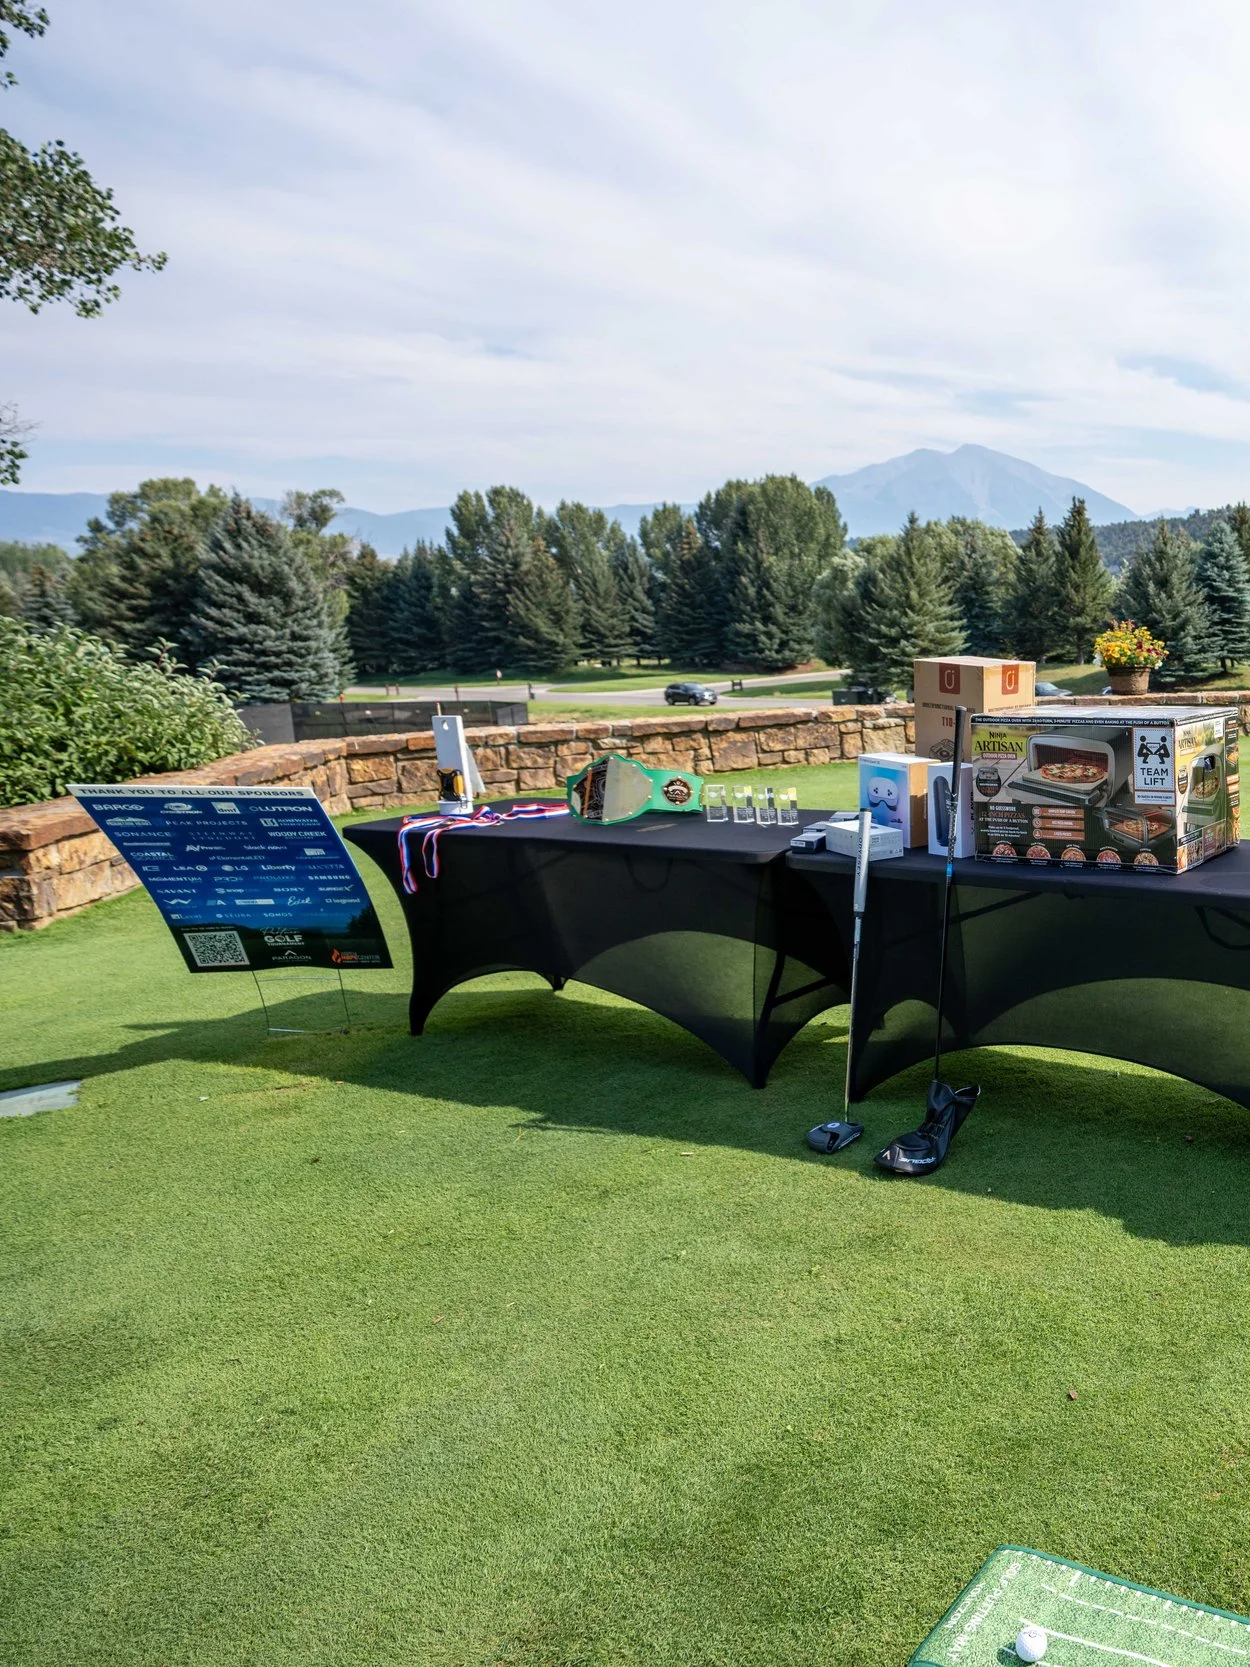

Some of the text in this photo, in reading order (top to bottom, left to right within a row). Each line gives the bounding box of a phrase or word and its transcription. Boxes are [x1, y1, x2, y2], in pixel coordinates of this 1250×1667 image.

[974, 740, 1023, 752] ARTISAN
[1140, 767, 1168, 776] TEAM
[1144, 777, 1165, 786] LIFT
[264, 935, 303, 943] GOLF
[945, 1562, 1021, 1660] GOLF PUTTING MAT
